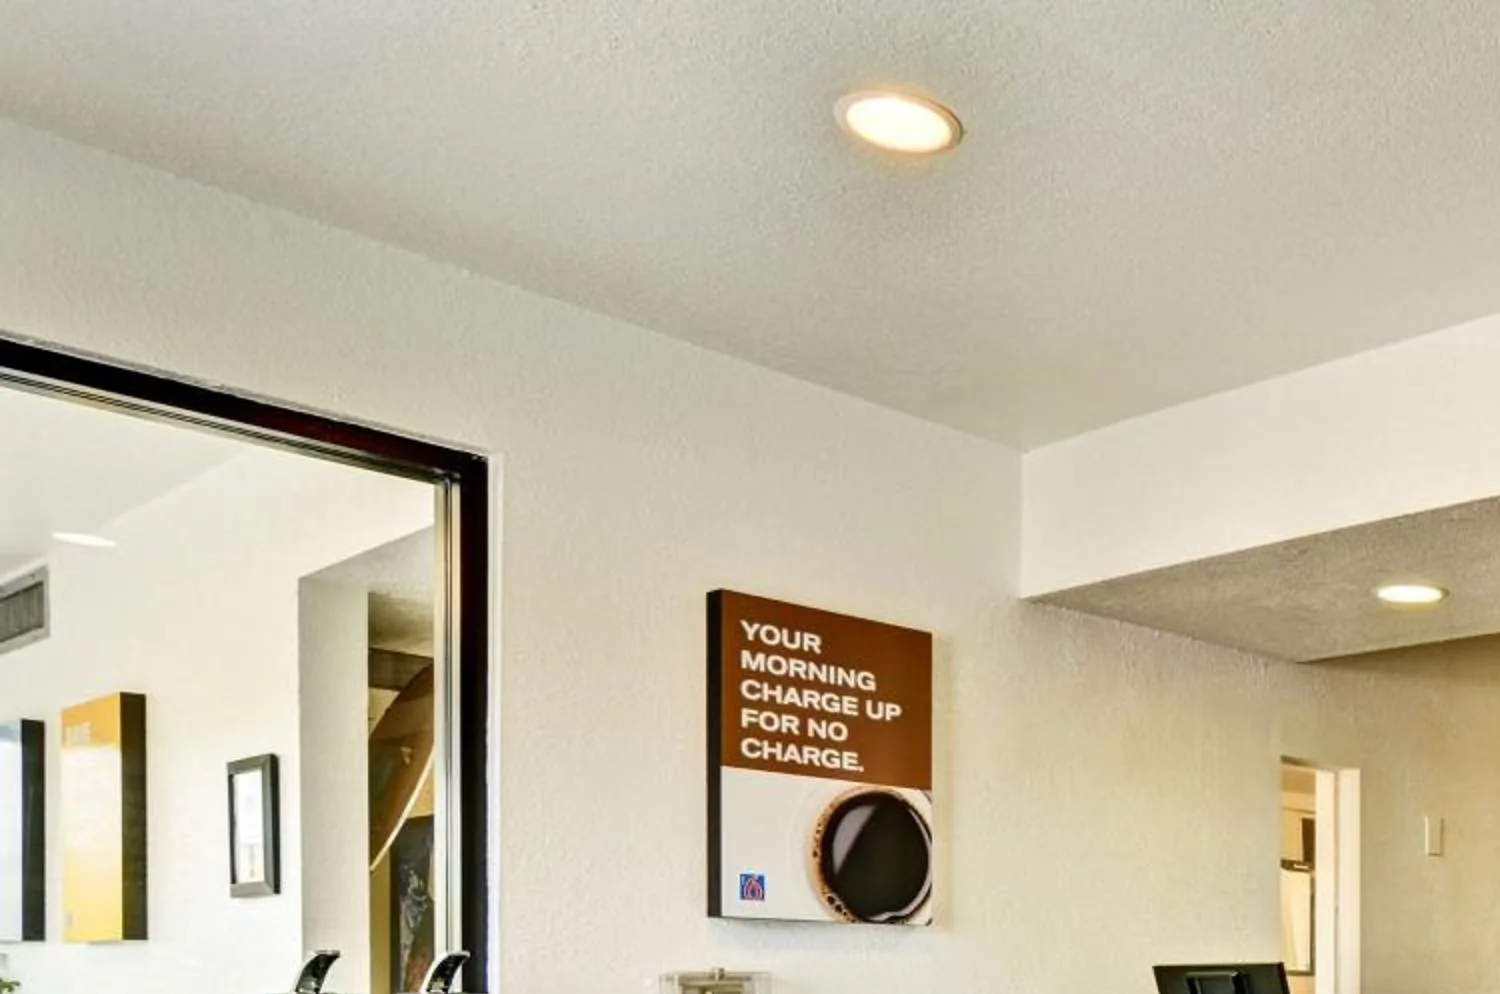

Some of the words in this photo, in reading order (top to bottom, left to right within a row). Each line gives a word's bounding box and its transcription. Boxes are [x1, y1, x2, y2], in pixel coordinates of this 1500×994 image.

[740, 620, 822, 654] YOUR
[740, 650, 877, 692] MORNING
[740, 679, 859, 716] CHARGE
[865, 698, 903, 722] UP
[740, 708, 800, 735] FOR
[807, 719, 848, 742] NO
[740, 737, 865, 772] CHARGE.
